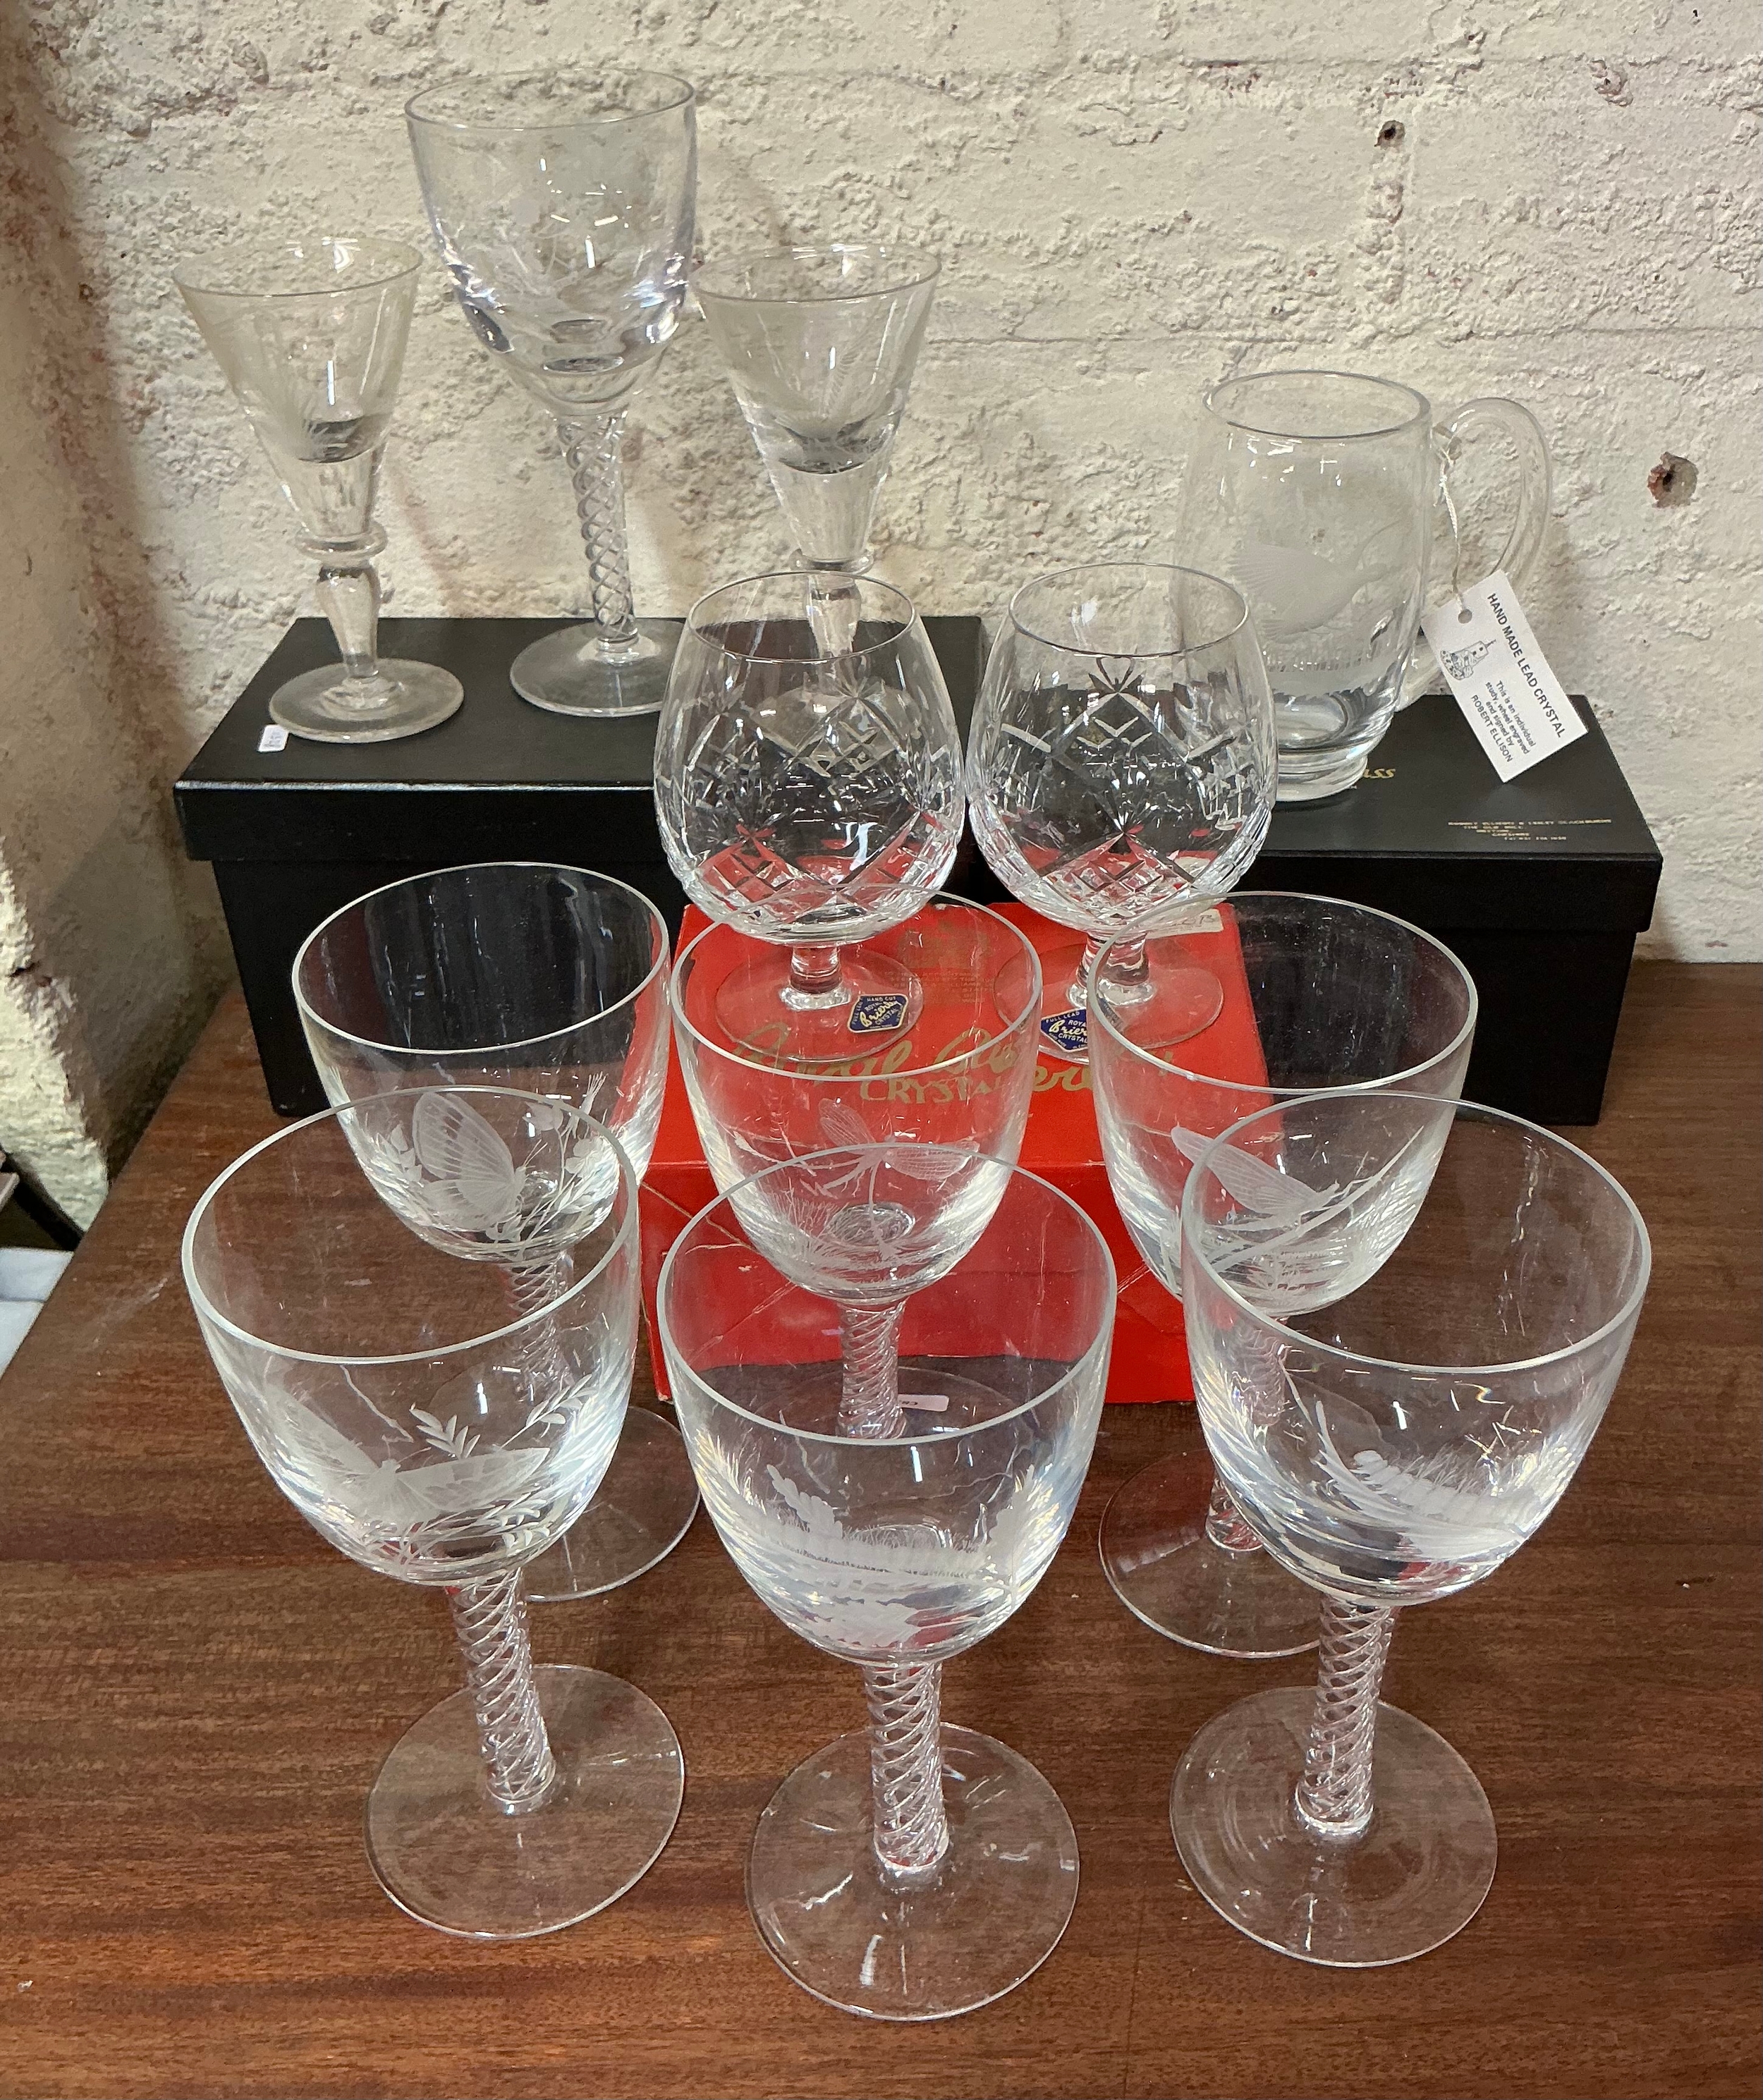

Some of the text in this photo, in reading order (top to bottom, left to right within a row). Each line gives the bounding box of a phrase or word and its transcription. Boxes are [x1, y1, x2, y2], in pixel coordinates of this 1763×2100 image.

[1487, 593, 1565, 738] HAND MADE LEAD CRYSTAL
[1470, 695, 1513, 762] ROBERT ELLISON
[1485, 682, 1530, 754] study, wheel engraved
[1486, 702, 1514, 746] and signed by
[1496, 680, 1506, 697] This
[1508, 704, 1515, 714] an
[1513, 713, 1536, 747] individual
[1048, 1019, 1088, 1037] Brier
[1057, 1032, 1088, 1044] CRYSTAL
[1068, 1019, 1087, 1027] ROYA
